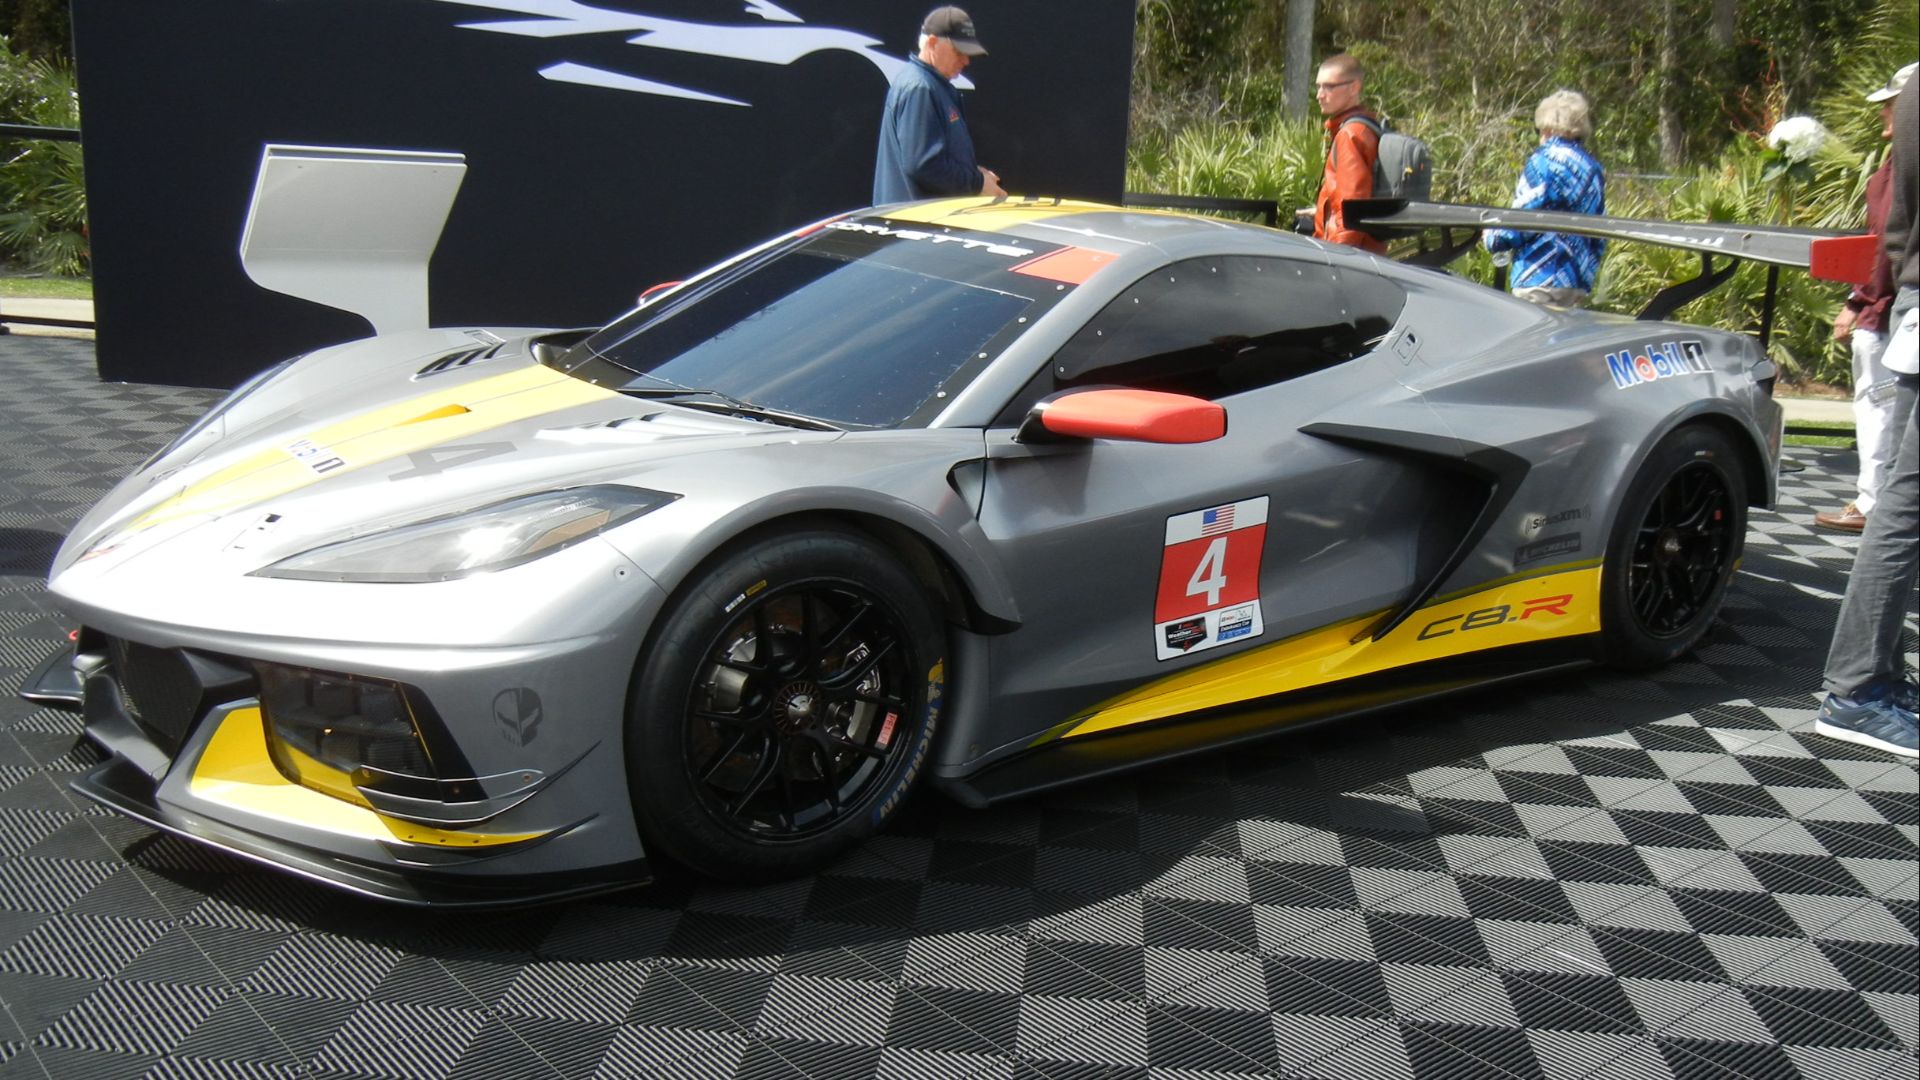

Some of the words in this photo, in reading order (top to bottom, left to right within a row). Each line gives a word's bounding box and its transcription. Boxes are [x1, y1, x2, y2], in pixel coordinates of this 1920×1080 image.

[825, 221, 1034, 257] CORVETTE
[1604, 341, 1689, 389] Mobil
[1683, 342, 1712, 373] 1
[1186, 536, 1228, 606] 4
[1416, 593, 1574, 641] C8.R
[880, 706, 940, 819] MICHELIN
